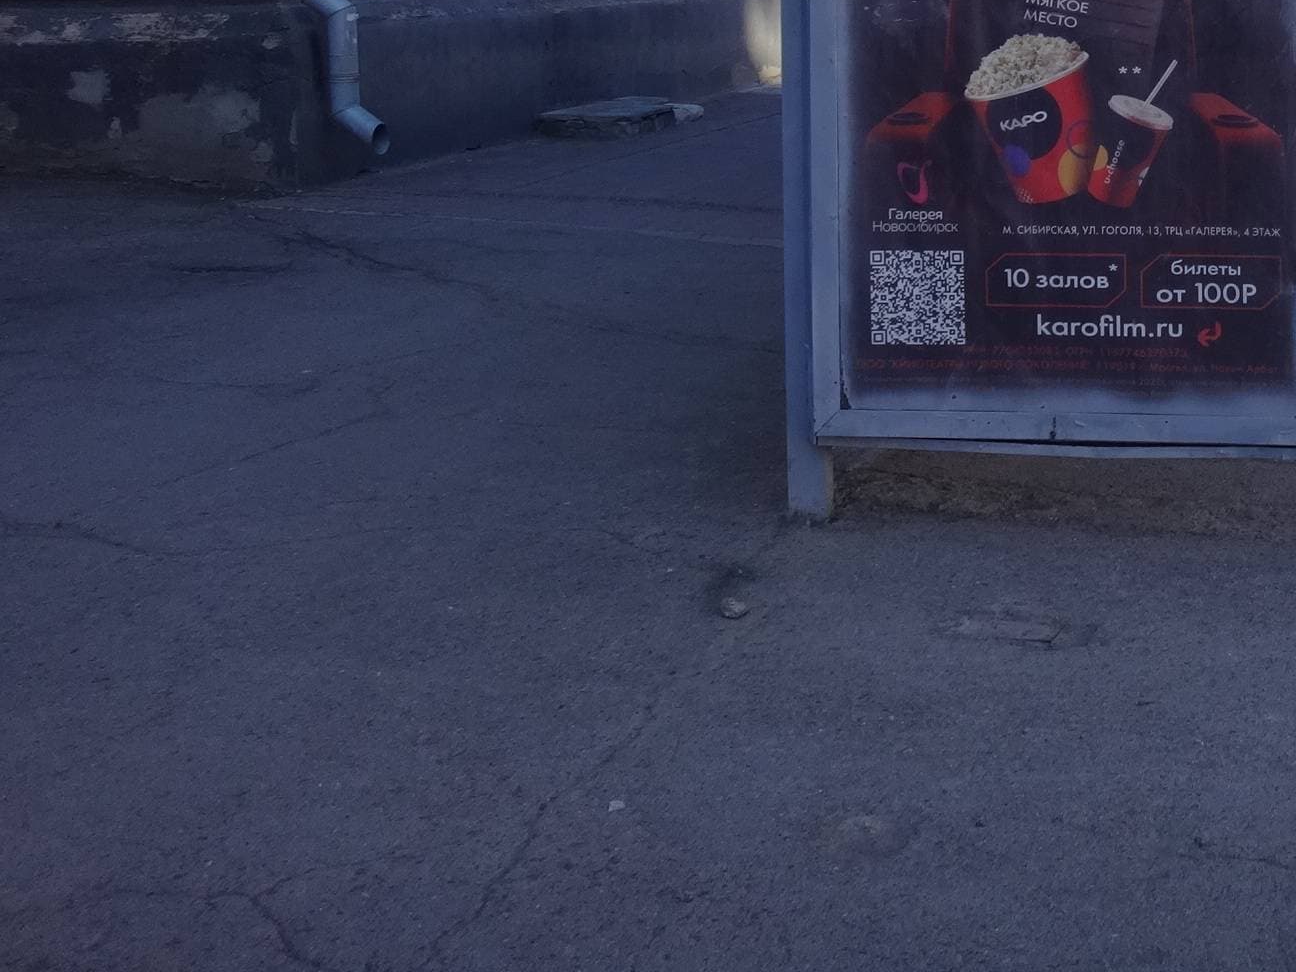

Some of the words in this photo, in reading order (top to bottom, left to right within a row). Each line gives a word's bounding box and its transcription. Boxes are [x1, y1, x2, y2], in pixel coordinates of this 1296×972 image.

[1023, 8, 1078, 28] МЕСТО
[1000, 110, 1048, 132] КАРО
[888, 207, 943, 221] Галерея
[872, 220, 959, 234] Новосибирск
[1002, 225, 1014, 235] М.
[1016, 225, 1080, 236] СИБИРСКАЯ,
[1082, 225, 1099, 235] УЛ.
[1101, 225, 1145, 236] ГОГОЛЯ,
[1148, 226, 1162, 236] 13,
[1165, 226, 1183, 236] ТРЦ
[1185, 226, 1241, 237] «ГАЛЕРЕЯ»,
[1243, 227, 1250, 236] 4
[1252, 227, 1281, 237] ЭТАЖ
[1170, 259, 1242, 277] билеты
[1004, 268, 1030, 288] 10
[1156, 288, 1186, 303] от
[1036, 314, 1183, 338] karofilm.ru
